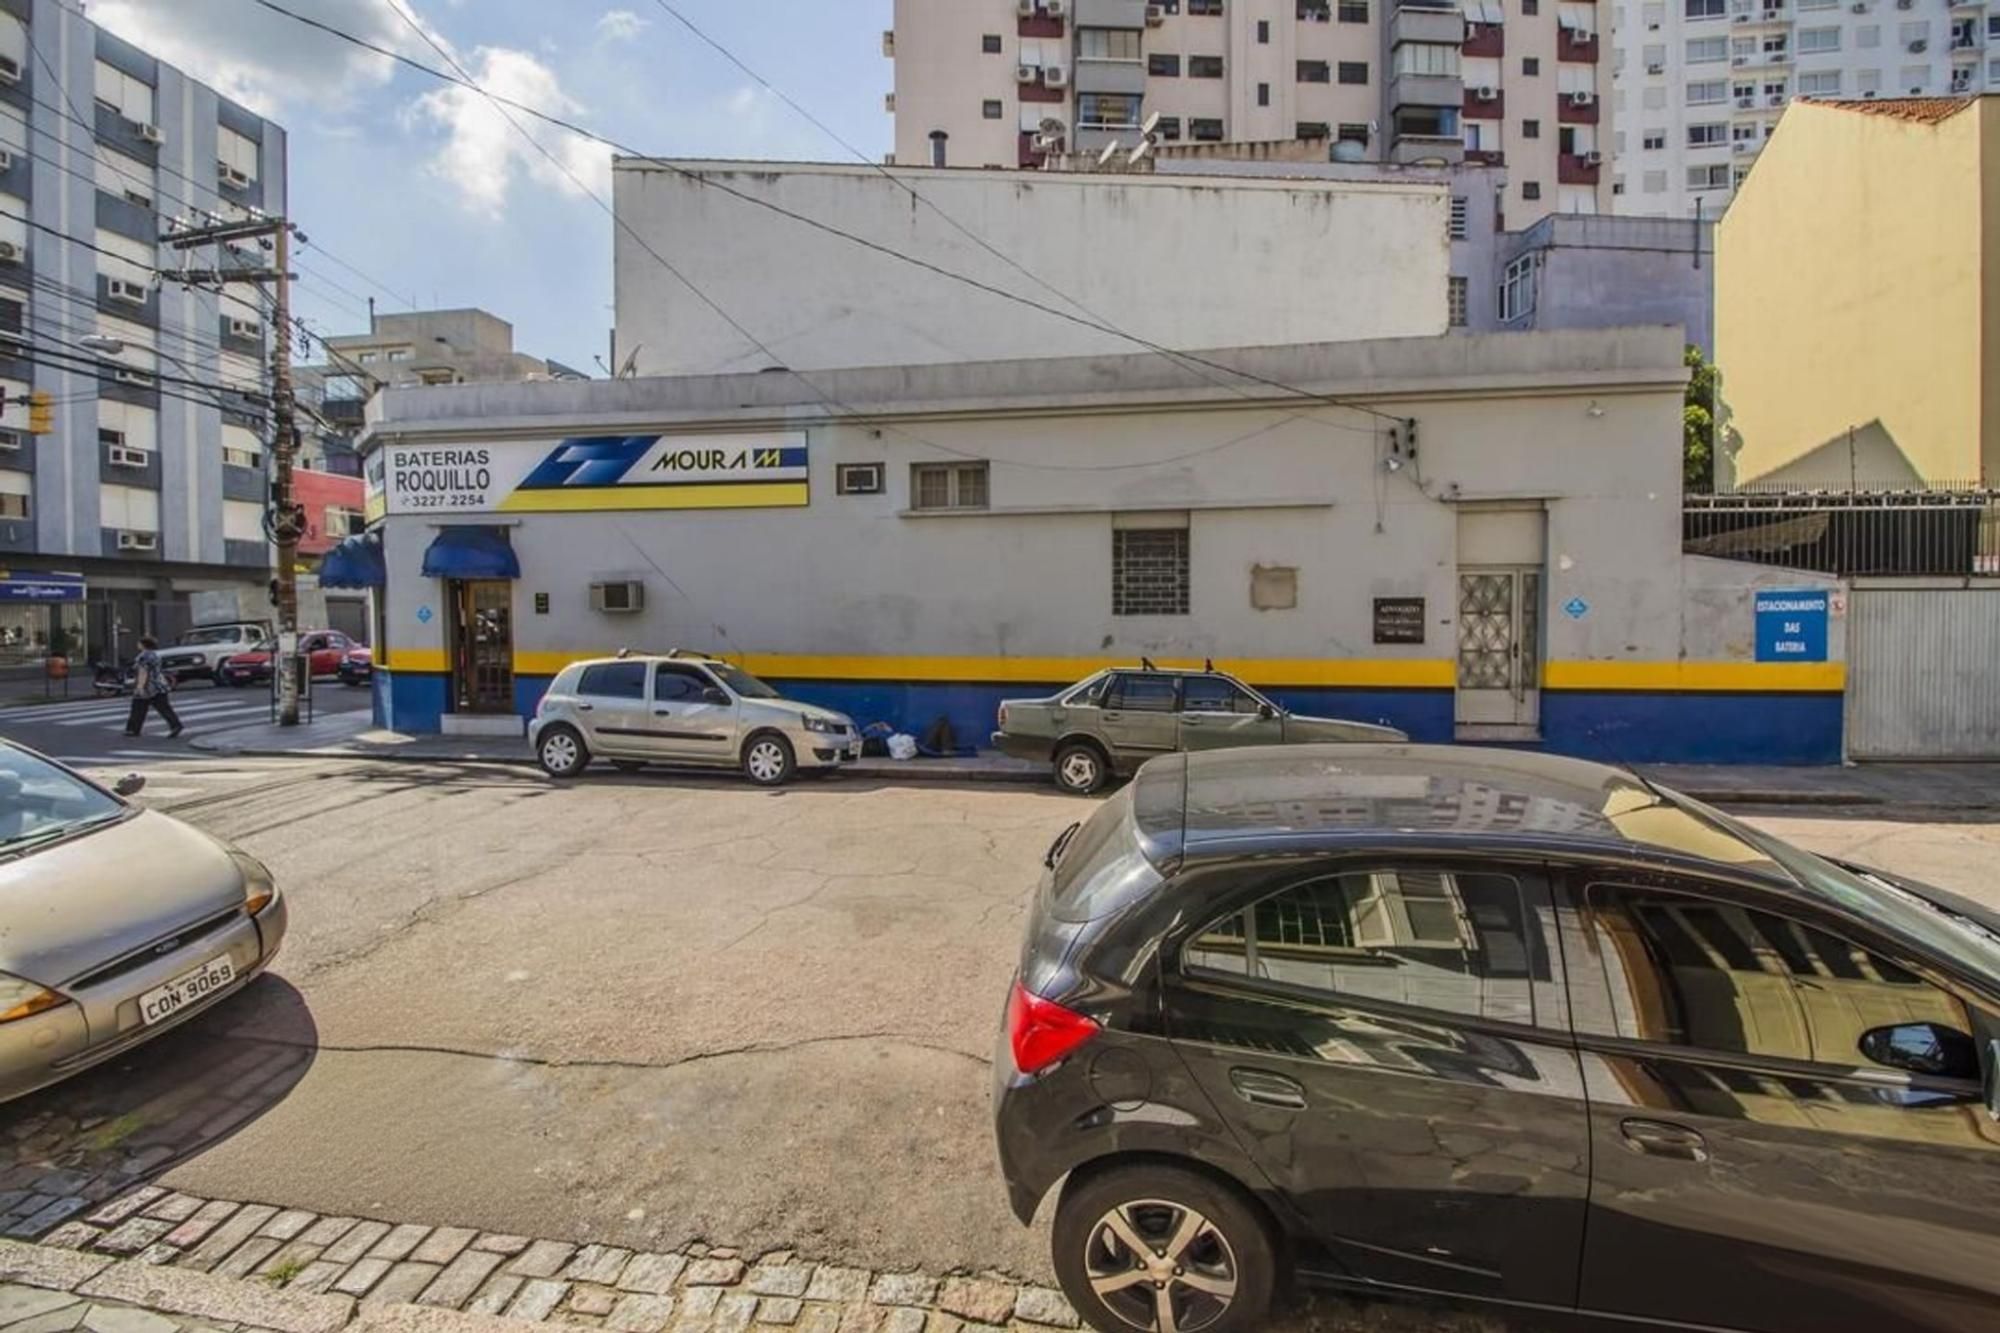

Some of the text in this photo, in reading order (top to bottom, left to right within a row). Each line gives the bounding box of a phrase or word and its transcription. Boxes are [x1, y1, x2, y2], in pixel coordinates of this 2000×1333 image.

[394, 449, 490, 468] BATERIAS
[651, 450, 746, 471] MOURA
[396, 468, 490, 492] ROQUILLO
[412, 494, 485, 507] 3227.2254
[1757, 600, 1825, 612] ESTACIONAMENTO
